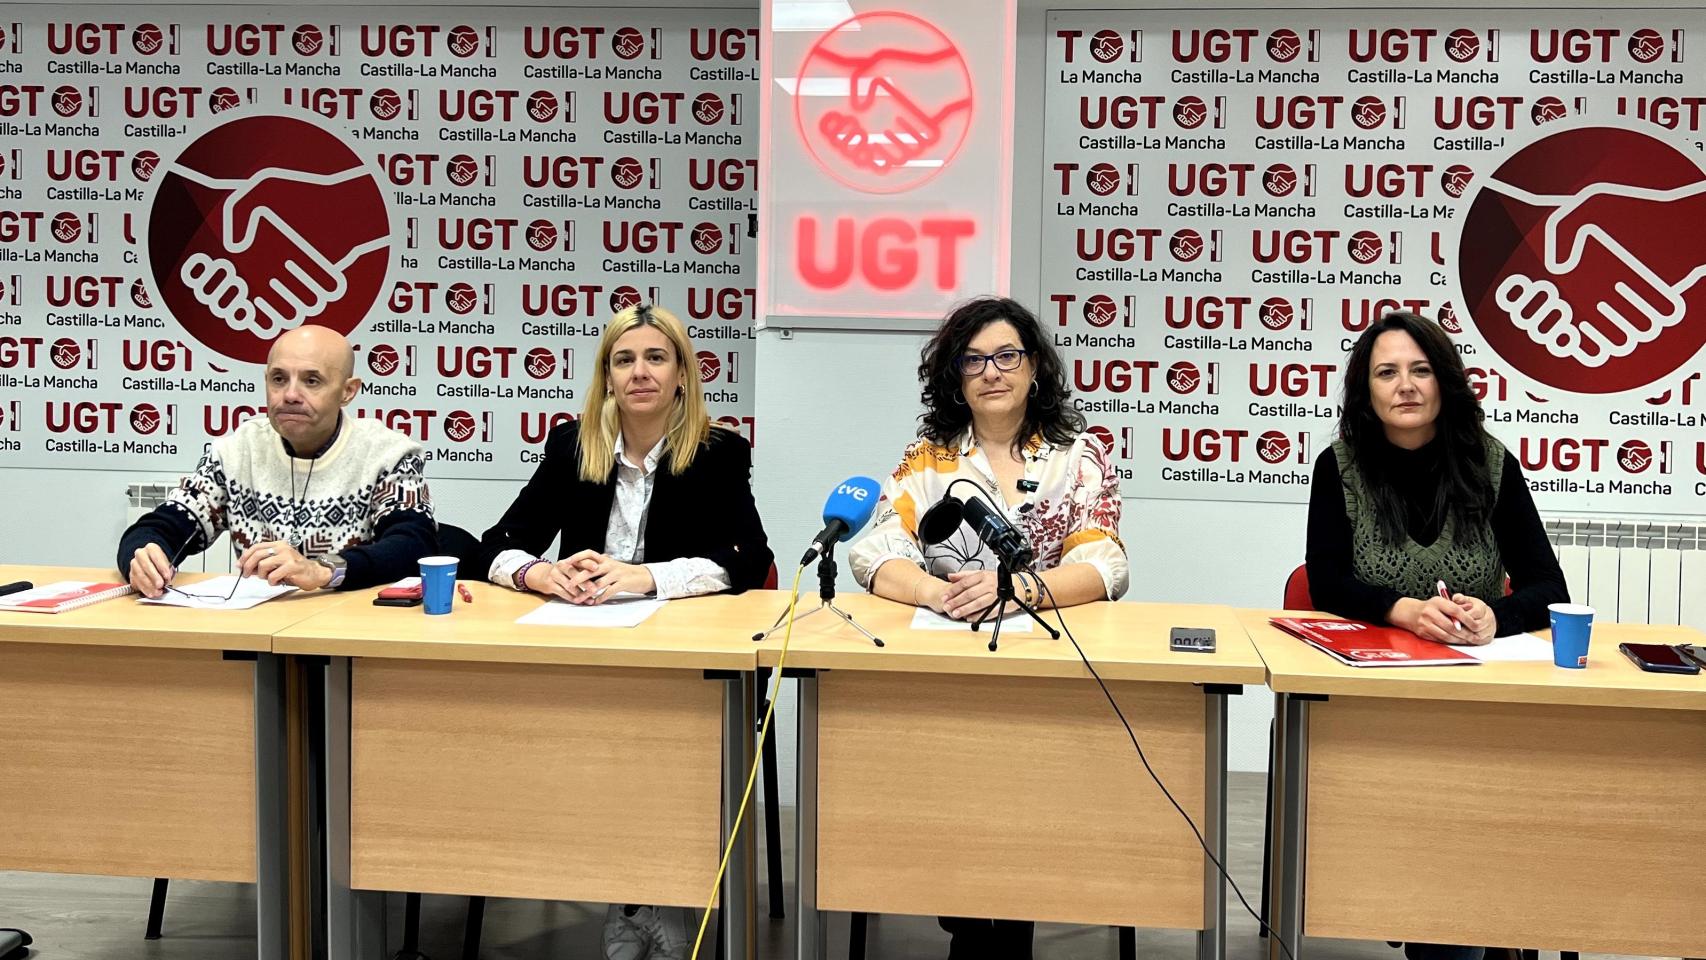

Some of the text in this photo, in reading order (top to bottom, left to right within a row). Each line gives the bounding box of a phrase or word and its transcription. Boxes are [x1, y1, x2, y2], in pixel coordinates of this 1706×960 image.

[47, 23, 126, 55] UGT
[207, 23, 285, 56] UGT
[360, 24, 441, 58] UGT
[524, 26, 605, 59] UGT
[1172, 29, 1259, 63] UGT
[1349, 28, 1438, 63] UGT
[1530, 28, 1621, 64] UGT
[0, 59, 23, 73] cha
[47, 60, 180, 75] Castilla-La Mancha
[206, 61, 341, 76] Castilla-La Mancha
[360, 63, 497, 78] Castilla-La Mancha
[524, 65, 662, 80] Castilla-La Mancha
[690, 67, 758, 81] Castilla-L
[1082, 69, 1142, 84] Mancha
[1171, 69, 1319, 83] Castilla-La Mancha
[1348, 68, 1499, 84] Castilla-La Mancha
[1529, 69, 1683, 84] Castilla-La Mancha
[0, 84, 45, 117] GT
[124, 86, 202, 119] UGT
[439, 89, 520, 122] UGT
[604, 91, 685, 125] UGT
[1080, 95, 1166, 130] UGT
[1256, 95, 1344, 130] UGT
[1434, 96, 1524, 131] UGT
[45, 123, 99, 137] Mancha
[124, 124, 186, 138] Castilla-
[363, 126, 419, 140] Mancha
[439, 127, 576, 143] Castilla-La Mancha
[603, 130, 742, 145] Castilla-La Mancha
[1079, 135, 1225, 150] Castilla-La Mancha
[1255, 135, 1405, 150] Castilla-La Mancha
[1433, 136, 1504, 151] Castilla-
[47, 149, 125, 182] UGT
[377, 153, 440, 186] GT
[523, 155, 604, 189] UGT
[1168, 163, 1255, 197] UGT
[1345, 164, 1434, 198] UGT
[0, 186, 22, 200] cha
[47, 187, 121, 201] Castilla-La
[440, 192, 496, 207] Mancha
[523, 193, 661, 210] Castilla-La Mancha
[689, 197, 757, 211] Castilla-L
[1079, 202, 1138, 216] Mancha
[1167, 202, 1316, 218] Castilla-La Mancha
[1344, 204, 1429, 219] Castilla-La
[0, 210, 44, 243] GT
[438, 218, 519, 251] UGT
[603, 221, 684, 254] UGT
[1077, 228, 1162, 262] UGT
[798, 217, 975, 290] UGT
[1252, 229, 1340, 264] UGT
[44, 249, 99, 263] Mancha
[438, 256, 575, 271] Castilla-La Mancha
[602, 259, 740, 275] Castilla-La Mancha
[1076, 267, 1222, 283] Castilla-La Mancha
[1251, 269, 1401, 285] Castilla-La Mancha
[46, 275, 124, 308] UGT
[387, 281, 439, 314] GT
[522, 284, 603, 317] UGT
[0, 311, 22, 325] cha
[46, 313, 165, 328] Castilla-La Manc
[1165, 296, 1252, 330] UGT
[438, 320, 495, 335] Mancha
[522, 322, 599, 337] Castilla-La
[686, 325, 756, 341] Castilla-L
[1076, 333, 1135, 348] Mancha
[1164, 335, 1312, 351] Castilla-La Mancha
[0, 336, 43, 369] GT
[437, 346, 517, 379] UGT
[44, 375, 98, 389] Mancha
[1074, 359, 1159, 393] UGT
[1249, 363, 1337, 397] UGT
[1466, 365, 1507, 403] GT
[122, 377, 255, 393] Castilla-La Mancha
[361, 382, 417, 396] Mancha
[437, 383, 574, 399] Castilla-La Mancha
[703, 389, 738, 403] ncha
[1073, 398, 1219, 415] Castilla-La Mancha
[1248, 402, 1332, 418] Castilla-La
[46, 401, 123, 434] UGT
[357, 408, 437, 441] GT
[1516, 409, 1579, 424] Mancha
[1609, 411, 1696, 427] Castilla-La
[0, 437, 21, 451] cha
[45, 438, 177, 455] Castilla-La Mancha
[1162, 428, 1249, 462] UGT
[437, 448, 493, 462] Mancha
[1520, 437, 1609, 472] UGT
[1162, 467, 1309, 485] Castilla-La Mancha
[838, 484, 868, 501] tve
[1609, 480, 1672, 495] Mancha
